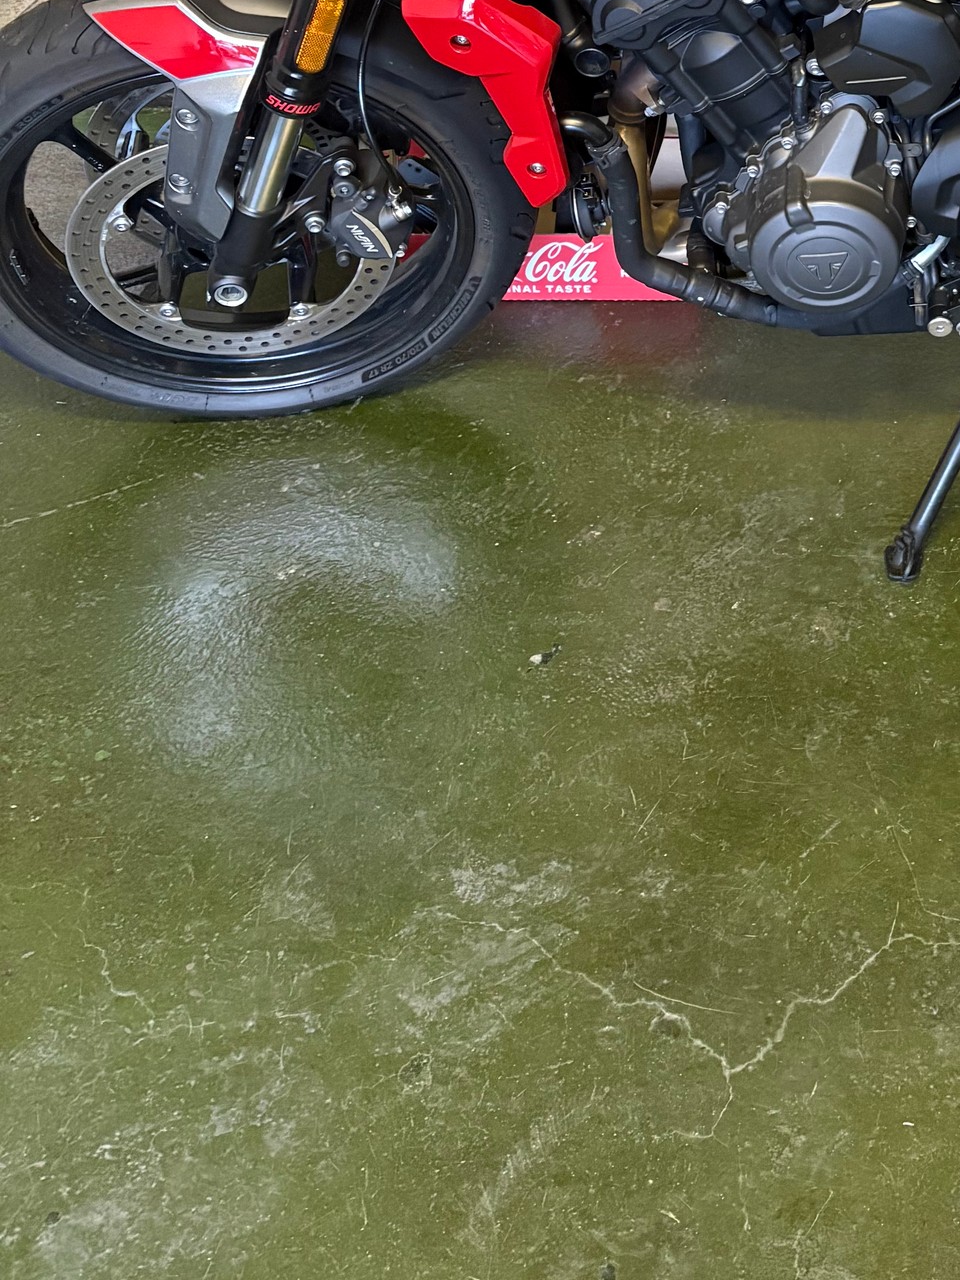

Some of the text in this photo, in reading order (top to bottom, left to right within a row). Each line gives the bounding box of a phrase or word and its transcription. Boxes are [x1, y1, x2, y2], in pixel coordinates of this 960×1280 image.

[265, 94, 321, 115] SHOWA
[545, 284, 592, 294] TASTE
[430, 291, 471, 340] MICHELIN
[394, 341, 426, 365] 120/70
[380, 361, 393, 373] ZR
